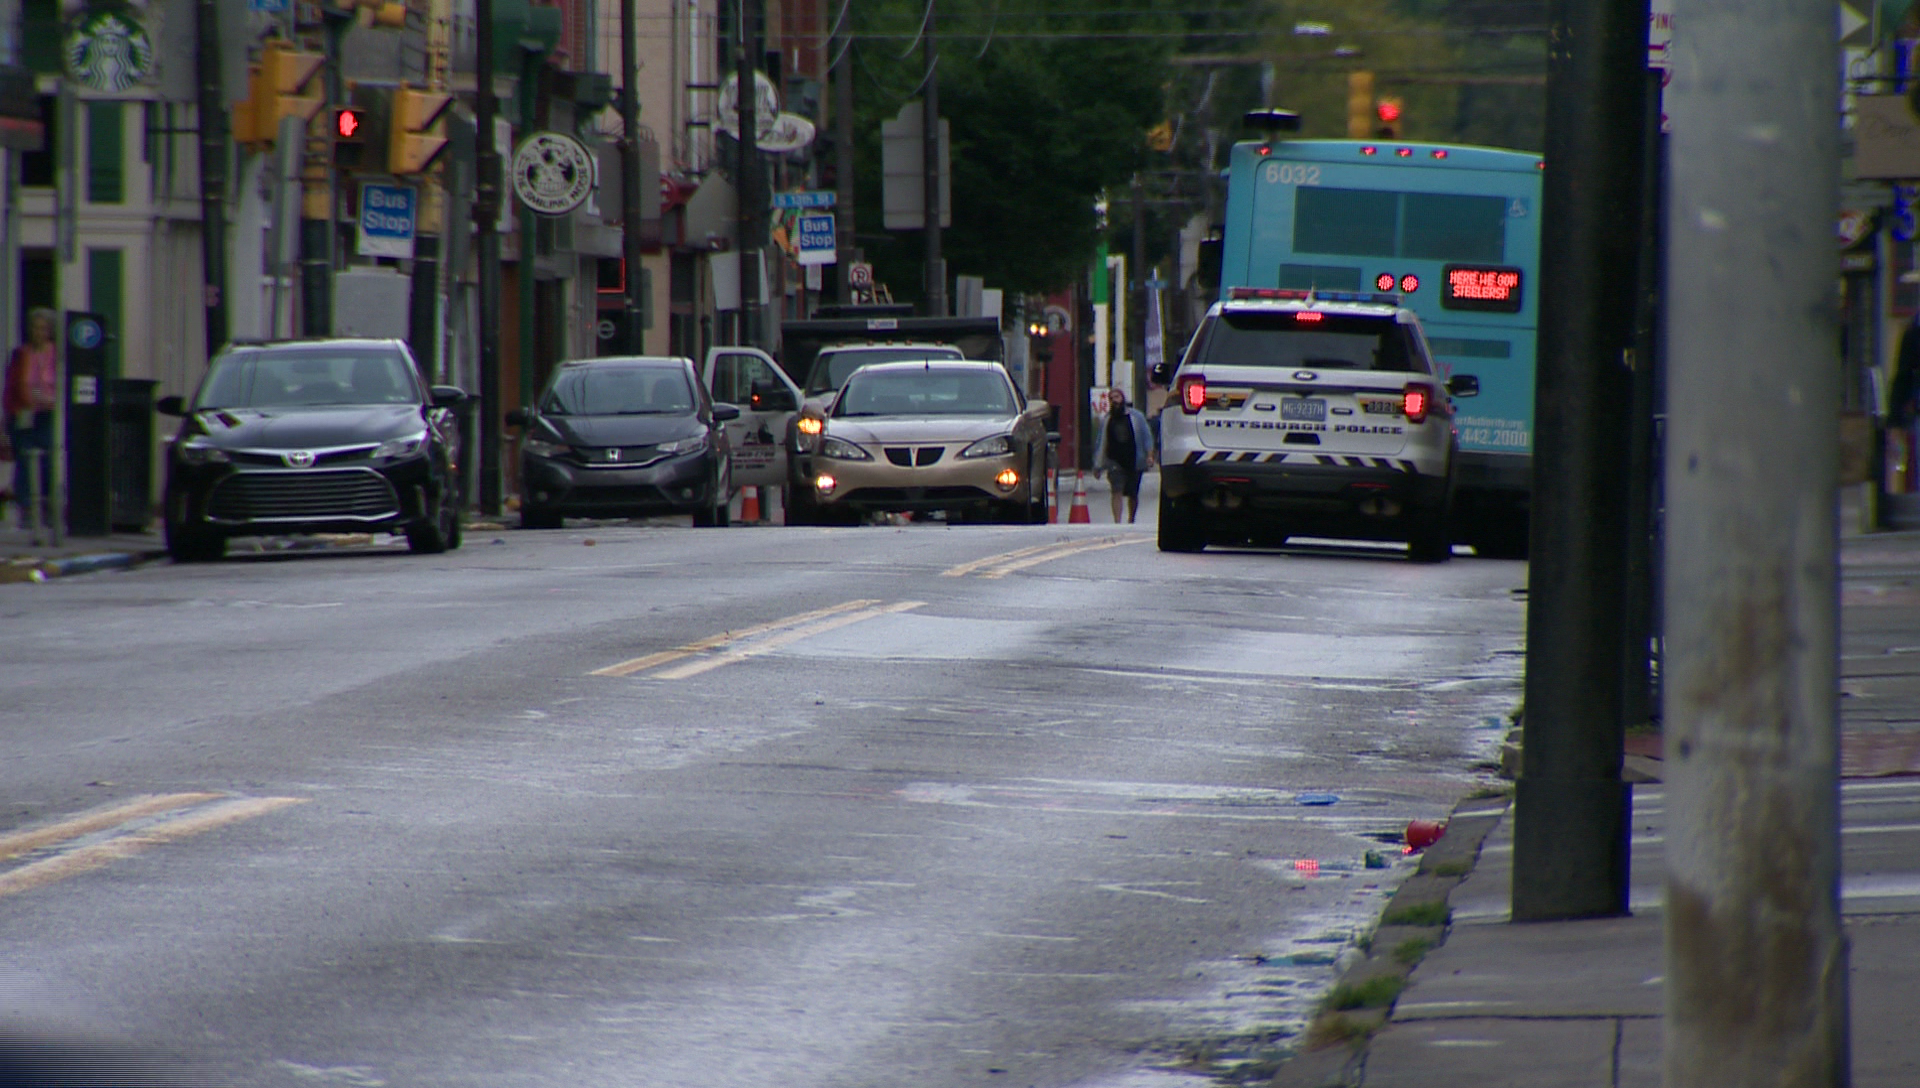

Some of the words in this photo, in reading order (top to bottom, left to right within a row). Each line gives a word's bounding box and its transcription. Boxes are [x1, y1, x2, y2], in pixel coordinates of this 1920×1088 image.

[1266, 163, 1320, 185] 6032
[370, 188, 407, 210] Bus
[365, 209, 411, 234] Stop
[803, 219, 830, 233] Bus
[801, 234, 833, 248] Stop
[1449, 270, 1480, 286] HERE
[1479, 271, 1498, 287] WE
[1204, 419, 1327, 432] PITTSBURGH
[1334, 424, 1403, 435] POLICE
